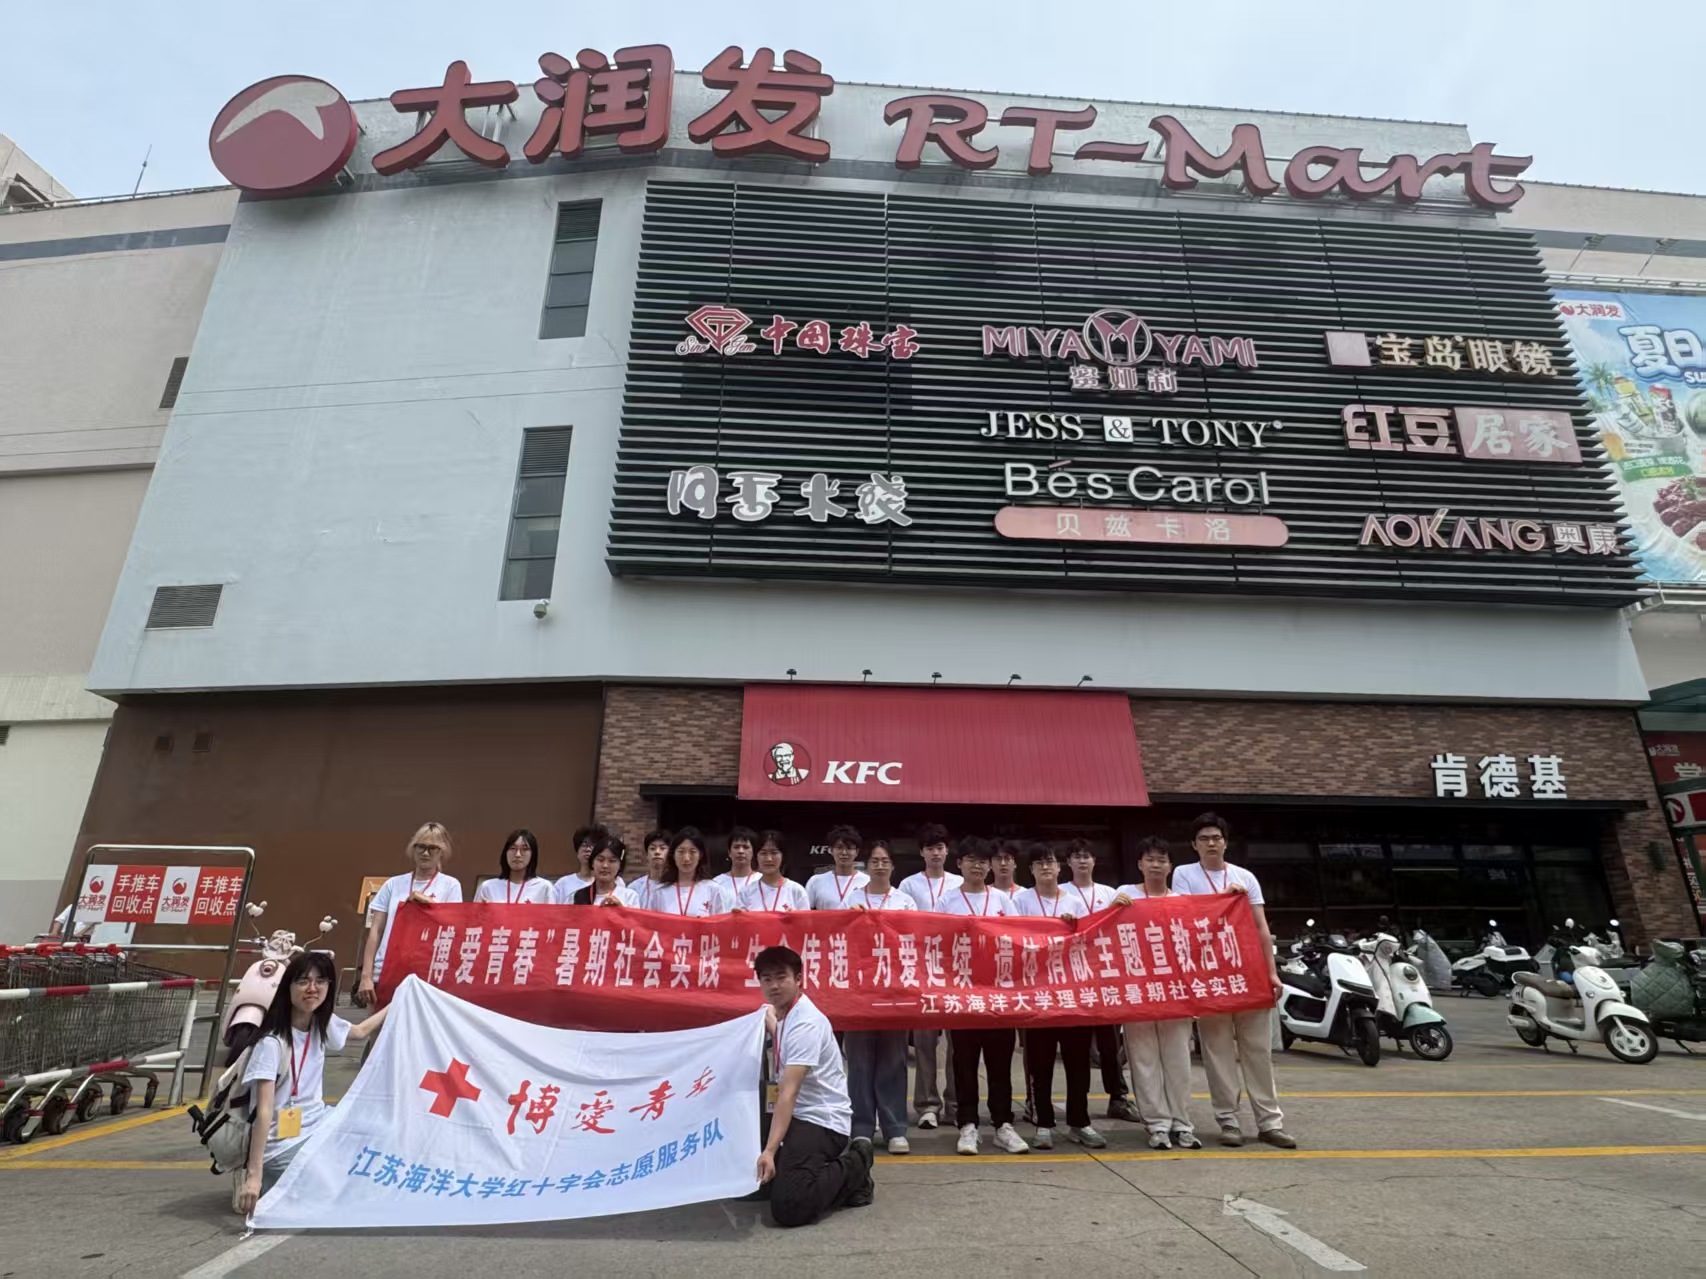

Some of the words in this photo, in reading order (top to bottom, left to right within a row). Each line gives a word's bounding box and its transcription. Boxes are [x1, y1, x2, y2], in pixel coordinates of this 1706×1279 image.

[372, 44, 834, 176] 大润发
[883, 94, 1533, 208] RT-Mart
[1575, 303, 1621, 317] 大润发
[761, 315, 920, 359] 中国珠宝
[1375, 333, 1558, 376] 宝岛眼镜
[1618, 325, 1704, 380] 夏日
[980, 410, 1085, 441] JESS
[1104, 416, 1133, 441] &
[1004, 459, 1114, 500] Bés
[1127, 466, 1270, 505] Carol
[1360, 507, 1546, 552] AOKANG
[1553, 522, 1621, 555] 奥康
[821, 760, 903, 785] KFC
[1430, 753, 1568, 799] 肯德基
[78, 894, 107, 906] 大润发
[116, 874, 161, 893] 手推车
[161, 896, 190, 907] 大润发
[199, 876, 244, 895] 手推车
[111, 894, 154, 914] 回收点
[194, 897, 239, 916] 回收点
[348, 1117, 725, 1199] 江苏海洋大学红十字会志愿服务队
